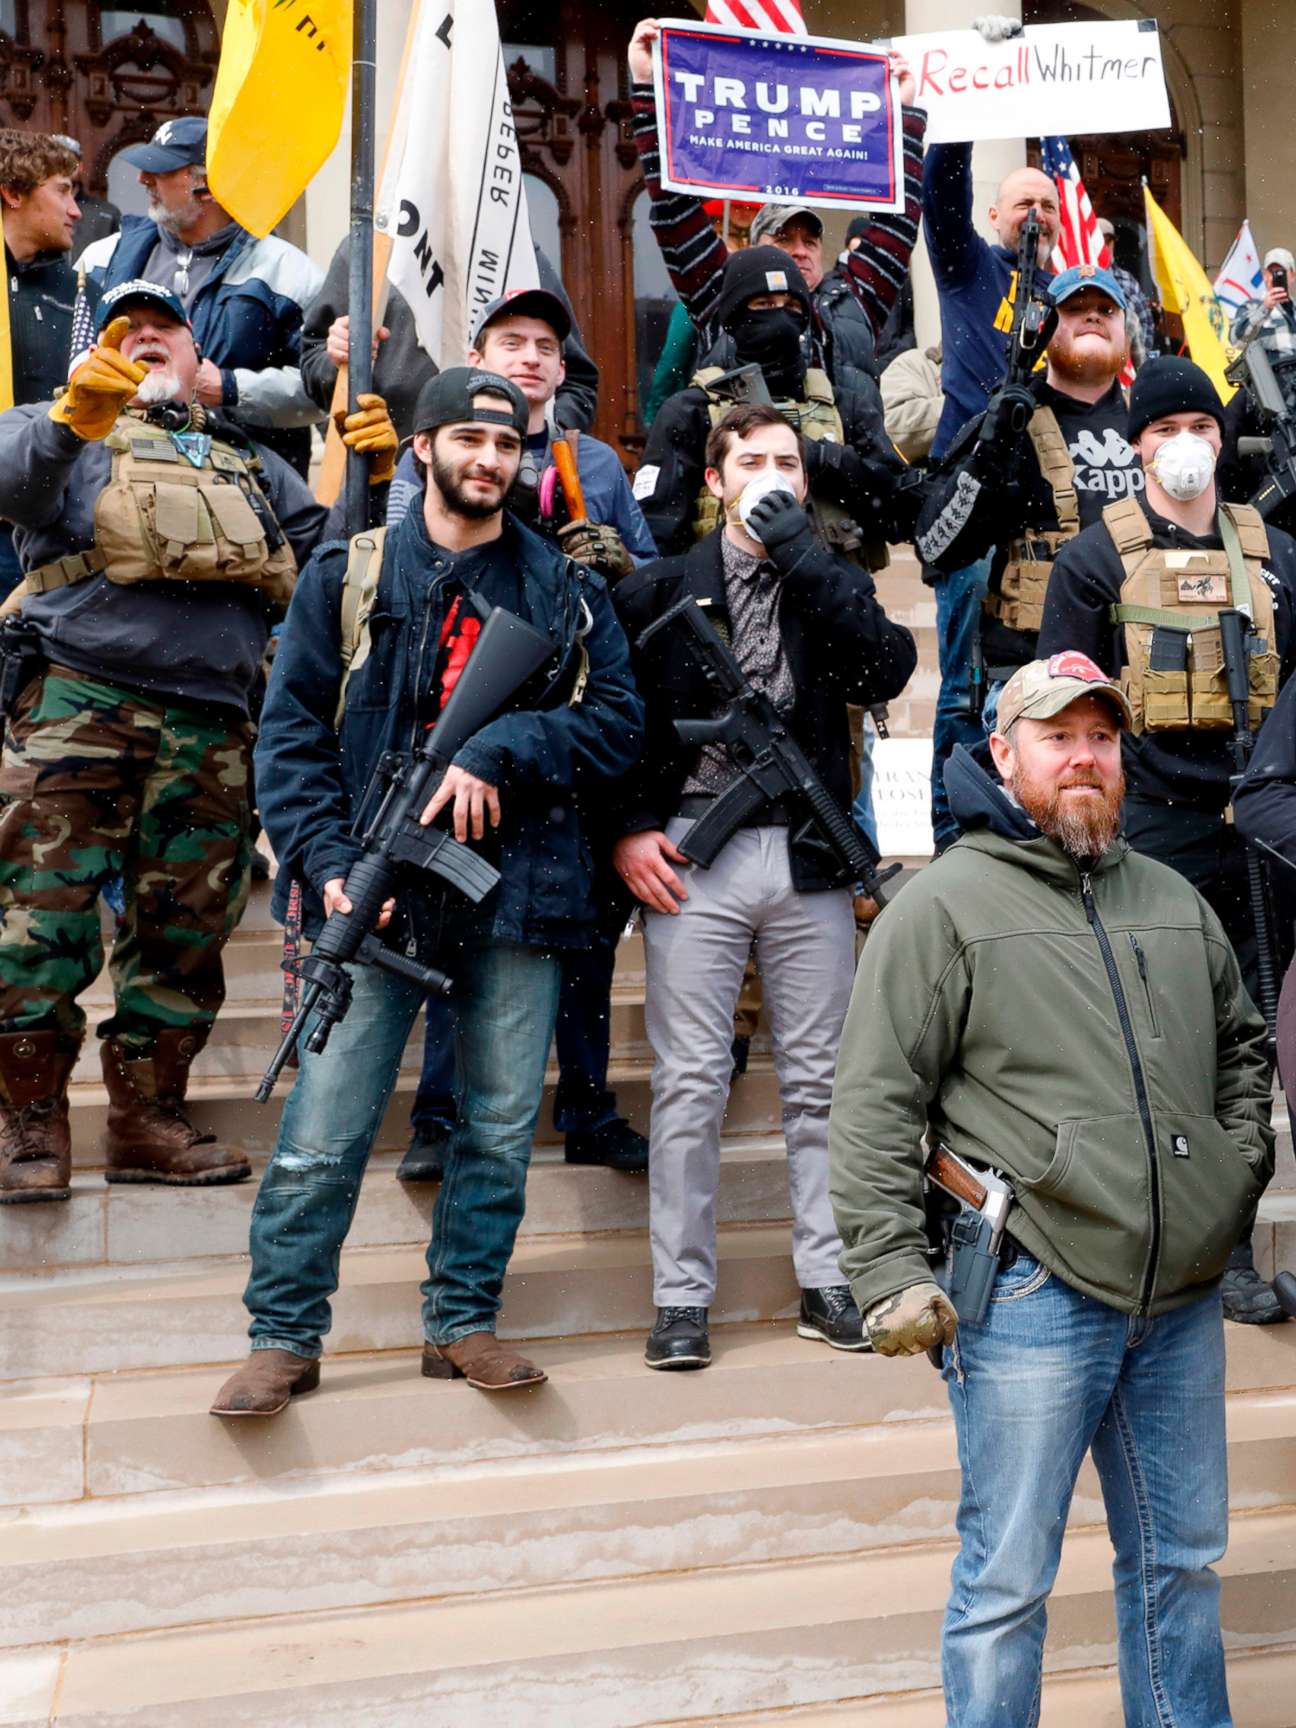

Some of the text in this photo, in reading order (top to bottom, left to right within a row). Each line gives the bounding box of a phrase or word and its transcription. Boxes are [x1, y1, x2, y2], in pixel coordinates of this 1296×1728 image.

[918, 43, 1157, 97] Recall Whitmer
[674, 71, 881, 120] TRUMP
[694, 109, 863, 143] PENCE
[689, 134, 868, 161] MAKE AMERICA GREAT AGAIN!
[765, 185, 799, 196] 2016
